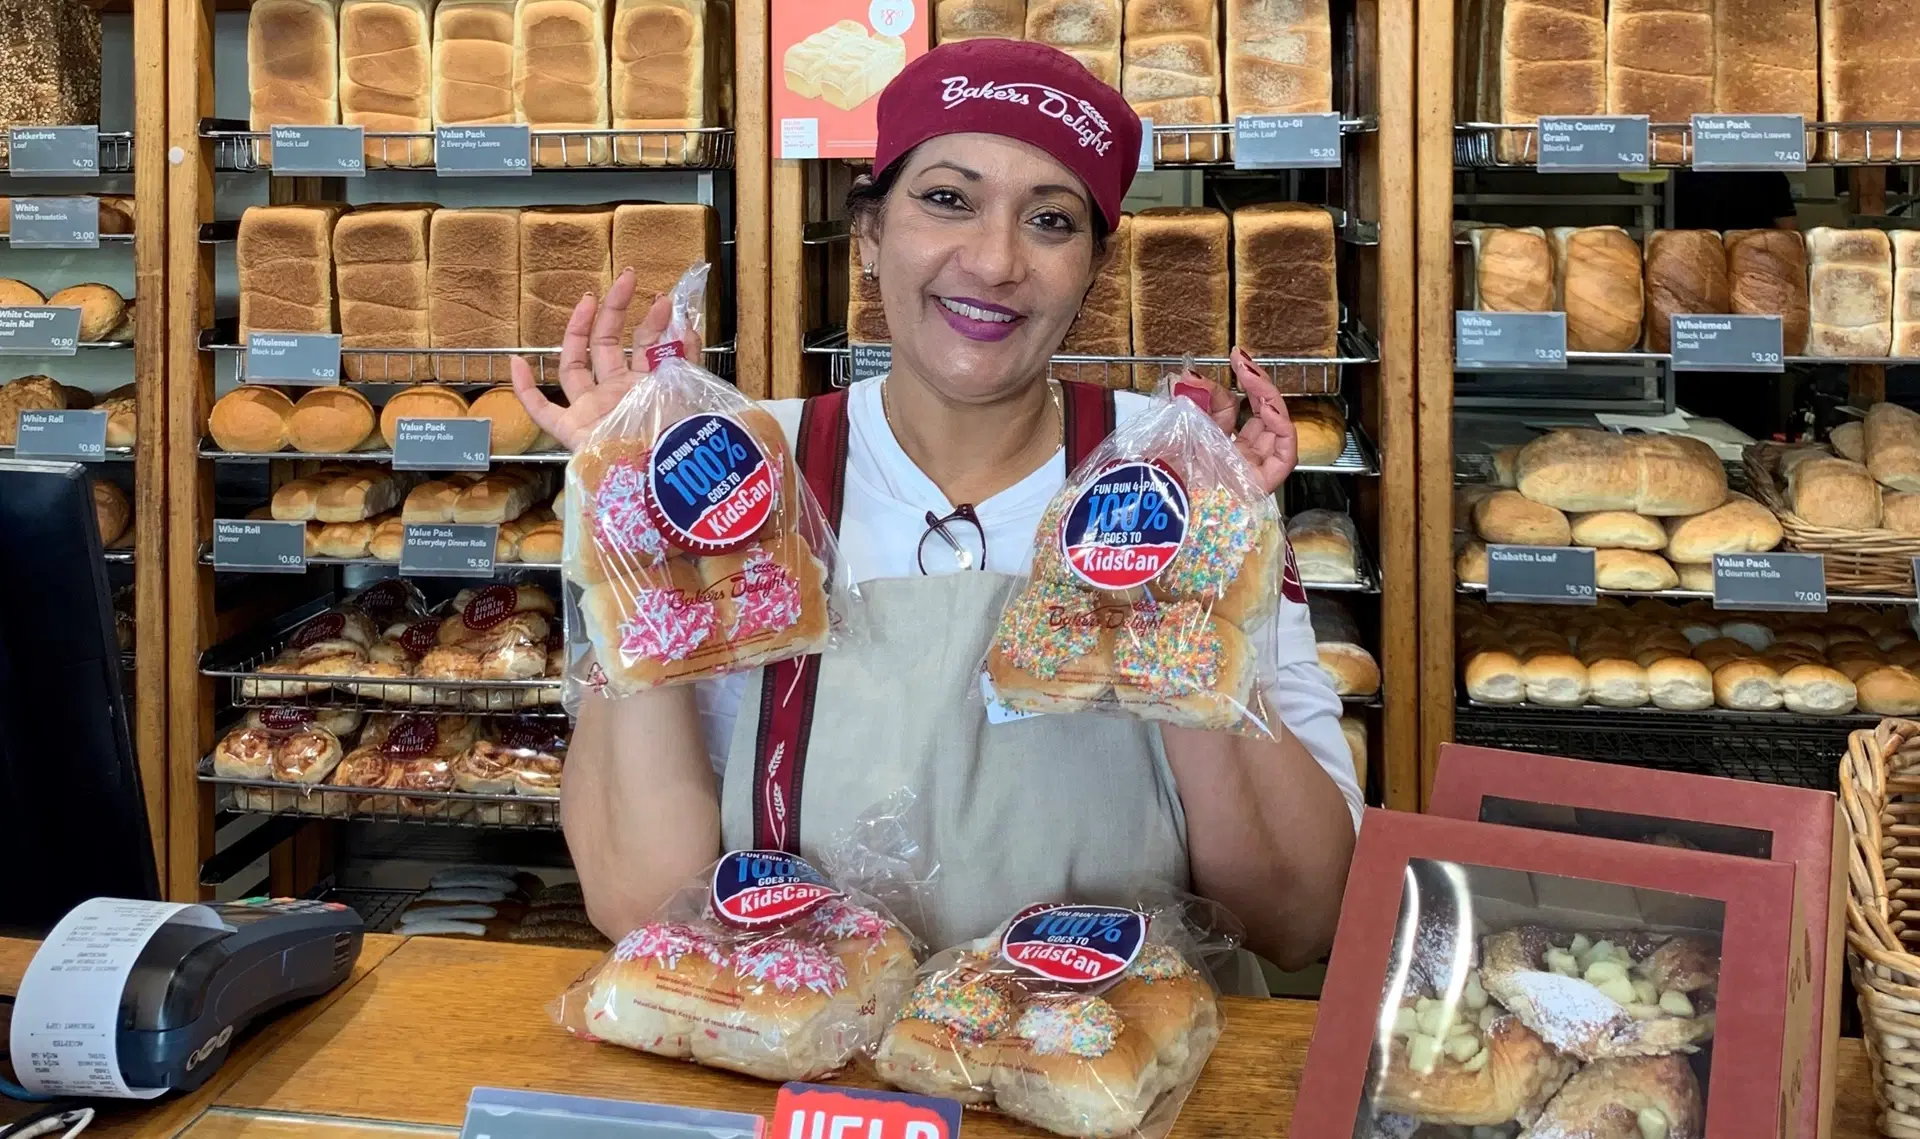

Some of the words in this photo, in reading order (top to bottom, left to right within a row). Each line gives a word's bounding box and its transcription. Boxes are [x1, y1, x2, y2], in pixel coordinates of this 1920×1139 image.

[942, 76, 1029, 109] Bakers
[1038, 91, 1112, 156] Delight
[1239, 120, 1276, 129] Hi-Fibre
[1277, 119, 1303, 128] Lo-GI
[1543, 122, 1573, 131] White
[1575, 122, 1615, 133] Country
[1697, 120, 1725, 129] Value
[1726, 120, 1751, 129] Pack
[276, 130, 301, 139] White
[440, 130, 461, 139] Value
[462, 130, 485, 139] Pack
[1543, 133, 1570, 142] Grain
[1704, 132, 1740, 140] Everyday
[276, 140, 295, 148] Block
[296, 140, 309, 148] Loaf
[441, 140, 446, 148] 2
[446, 140, 476, 149] Everyday
[477, 140, 501, 148] Loaves
[1543, 144, 1564, 152] Block
[1310, 148, 1336, 157] $5.20
[1774, 151, 1800, 160] $7.40
[503, 157, 527, 167] $6.90
[1617, 153, 1644, 162] $4.70
[73, 159, 94, 167] $4.70
[338, 158, 360, 167] $4.20
[15, 204, 39, 212] White
[72, 230, 95, 240] $3.00
[0, 310, 22, 318] White
[23, 311, 56, 320] Country
[18, 320, 35, 328] Roll
[1462, 317, 1492, 326] White
[1676, 321, 1731, 330] Wholemeal
[1462, 328, 1483, 336] Block
[1484, 328, 1501, 336] Loaf
[1676, 331, 1699, 339] Block
[1700, 331, 1717, 339] Loaf
[51, 338, 73, 346] $0.90
[252, 338, 298, 347] Wholemeal
[1676, 341, 1699, 349] Small
[271, 348, 286, 356] Loaf
[855, 349, 865, 357] Hi
[866, 349, 891, 357] Prote
[1535, 348, 1561, 358] $3.20
[1751, 352, 1779, 362] $3.20
[855, 358, 892, 369] Wholegr
[312, 368, 335, 377] $4.20
[23, 415, 47, 423] White
[48, 415, 64, 423] Roll
[400, 423, 424, 431] Value
[425, 423, 446, 431] Pack
[406, 433, 436, 442] Everyday
[437, 433, 454, 441] Rolls
[78, 444, 101, 452] $0.90
[656, 456, 677, 475] FUN
[673, 442, 693, 462] BUN
[689, 418, 722, 447] 4-PACK
[463, 452, 485, 461] $4.10
[664, 427, 748, 506] 100%
[707, 480, 731, 503] GOES
[727, 472, 741, 486] TO
[1093, 483, 1112, 495] FUN
[1112, 482, 1131, 493] BUN
[707, 479, 771, 537] KidsCan
[1088, 492, 1168, 532] 100%
[218, 525, 243, 534] White
[244, 525, 260, 534] Roll
[409, 528, 432, 537] Value
[433, 528, 453, 537] Pack
[218, 535, 240, 543] Dinner
[1103, 532, 1127, 544] GOES
[1130, 531, 1142, 543] TO
[417, 539, 446, 548] Everyday
[278, 554, 301, 564] $0.60
[1083, 550, 1159, 572] KidsCan
[1491, 551, 1534, 561] Ciabatta
[1535, 553, 1557, 562] Loaf
[467, 558, 490, 567] $5.50
[1717, 558, 1745, 568] Value
[1746, 558, 1770, 568] Pack
[1717, 569, 1723, 577] 6
[1725, 569, 1759, 578] Gourmet
[1761, 570, 1780, 578] Rolls
[730, 571, 786, 598] Delight
[1565, 584, 1592, 595] $5.70
[1795, 591, 1821, 601] $7.00
[758, 877, 784, 887] GOES
[740, 886, 821, 914] KidsCan
[1033, 915, 1128, 943] 100%
[1047, 935, 1073, 944] GOES
[1075, 936, 1090, 945] TO
[1018, 945, 1101, 977] KidsCan
